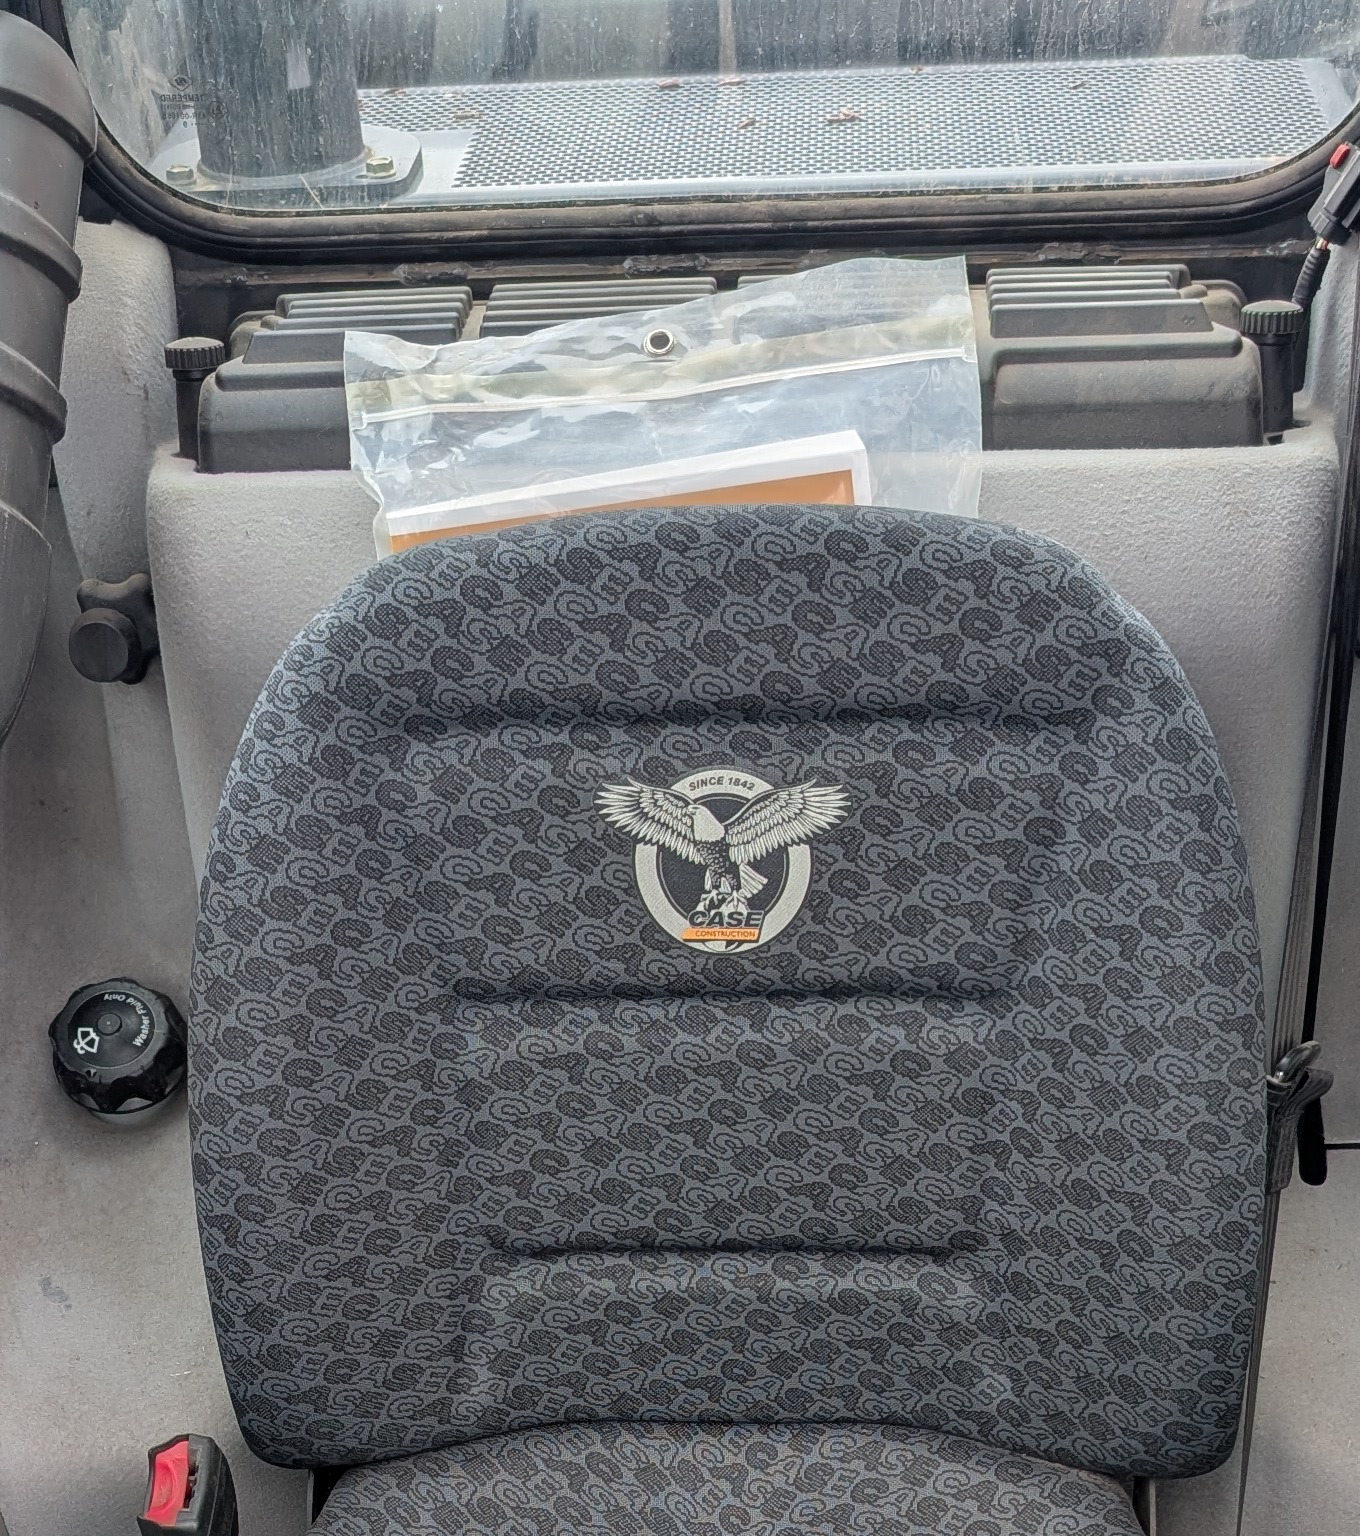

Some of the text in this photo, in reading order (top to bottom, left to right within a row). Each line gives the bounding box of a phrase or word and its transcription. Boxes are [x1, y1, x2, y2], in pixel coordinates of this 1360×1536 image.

[688, 776, 756, 792] SINCE 1842
[687, 909, 765, 928] CASE
[695, 929, 757, 940] CONSTRUCTION
[126, 998, 147, 1015] Fluid
[133, 1015, 150, 1046] Washer
